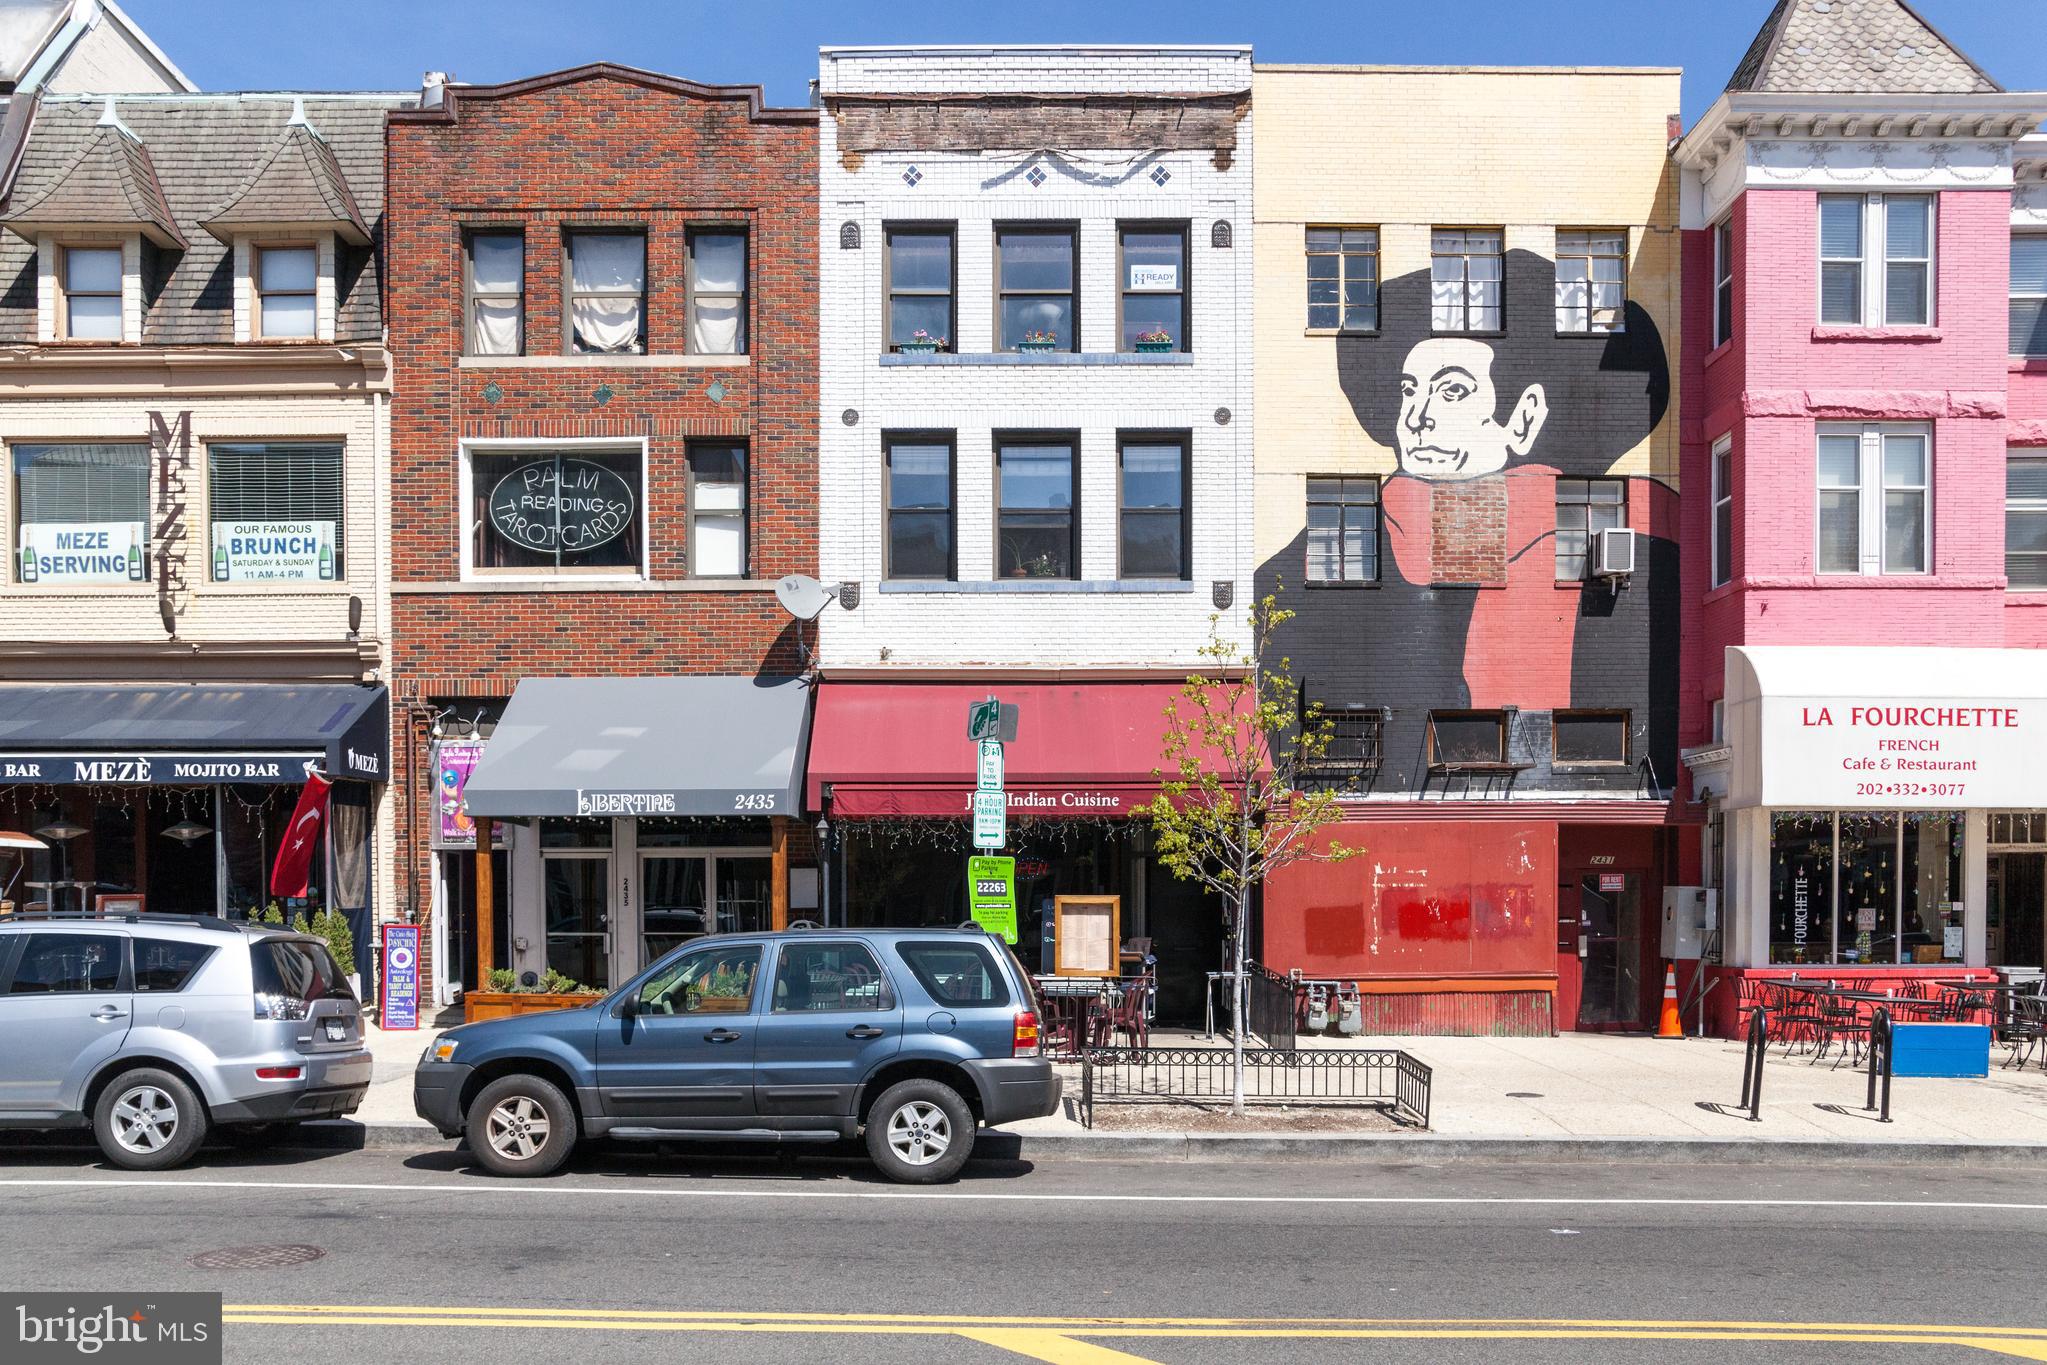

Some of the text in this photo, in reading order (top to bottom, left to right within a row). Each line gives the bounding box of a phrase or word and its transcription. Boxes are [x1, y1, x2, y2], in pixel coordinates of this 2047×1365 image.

[523, 466, 600, 492] PALM
[145, 410, 194, 593] MEZE
[521, 495, 604, 512] READING
[234, 524, 312, 534] OUR FAMOUS
[496, 499, 627, 546] TAROT CARDS
[56, 532, 109, 549] MEZE
[231, 537, 316, 555] BRUNCH
[40, 555, 125, 574] SERVING
[232, 558, 274, 567] SATURDAY
[283, 558, 315, 567] SUNDAY
[244, 570, 254, 579] 11
[287, 570, 304, 579] PM
[1803, 707, 2019, 727] LA FOURCHETTE
[1878, 739, 1940, 752] FRENCH
[5, 757, 280, 782] BAR MEZÈ MOJITO BAR
[1843, 757, 1977, 771] Cafe & Restaurant
[734, 794, 775, 810] 2435
[977, 798, 982, 807] 4
[984, 798, 1003, 808] HOUR
[1007, 792, 1119, 807] Indian Cuisine
[977, 807, 1003, 817] PARKING
[1016, 863, 1048, 875] PEN
[977, 882, 1006, 893] 22263
[1794, 877, 1808, 945] FOURCHETTE
[388, 938, 415, 948] PSYCHIC
